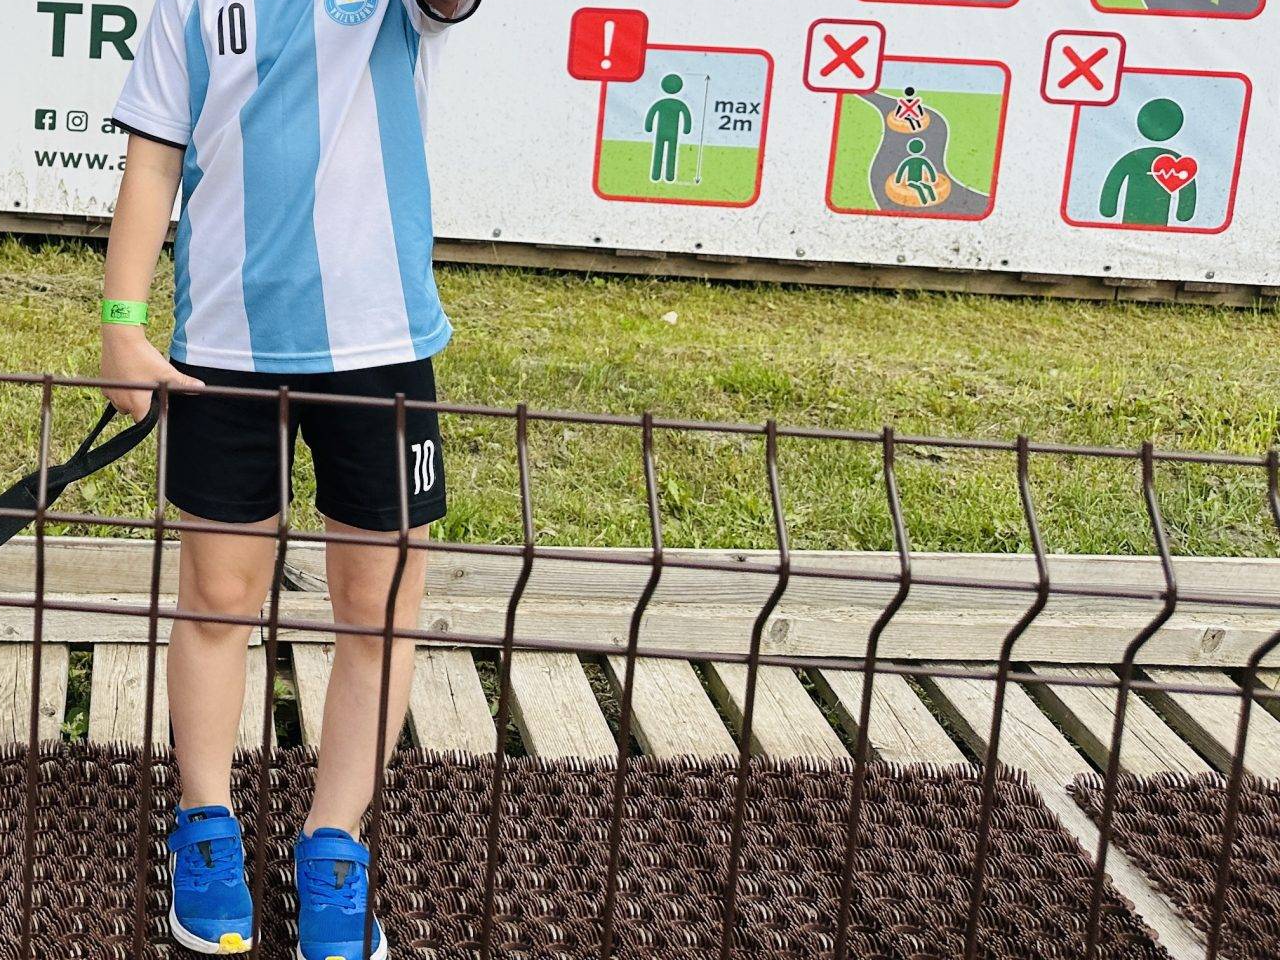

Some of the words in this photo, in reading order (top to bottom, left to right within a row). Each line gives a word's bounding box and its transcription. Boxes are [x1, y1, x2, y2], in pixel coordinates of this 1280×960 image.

[217, 2, 248, 56] 10
[714, 100, 761, 115] max
[718, 115, 752, 132] 2m
[34, 150, 127, 171] www.a
[412, 440, 435, 495] 10
